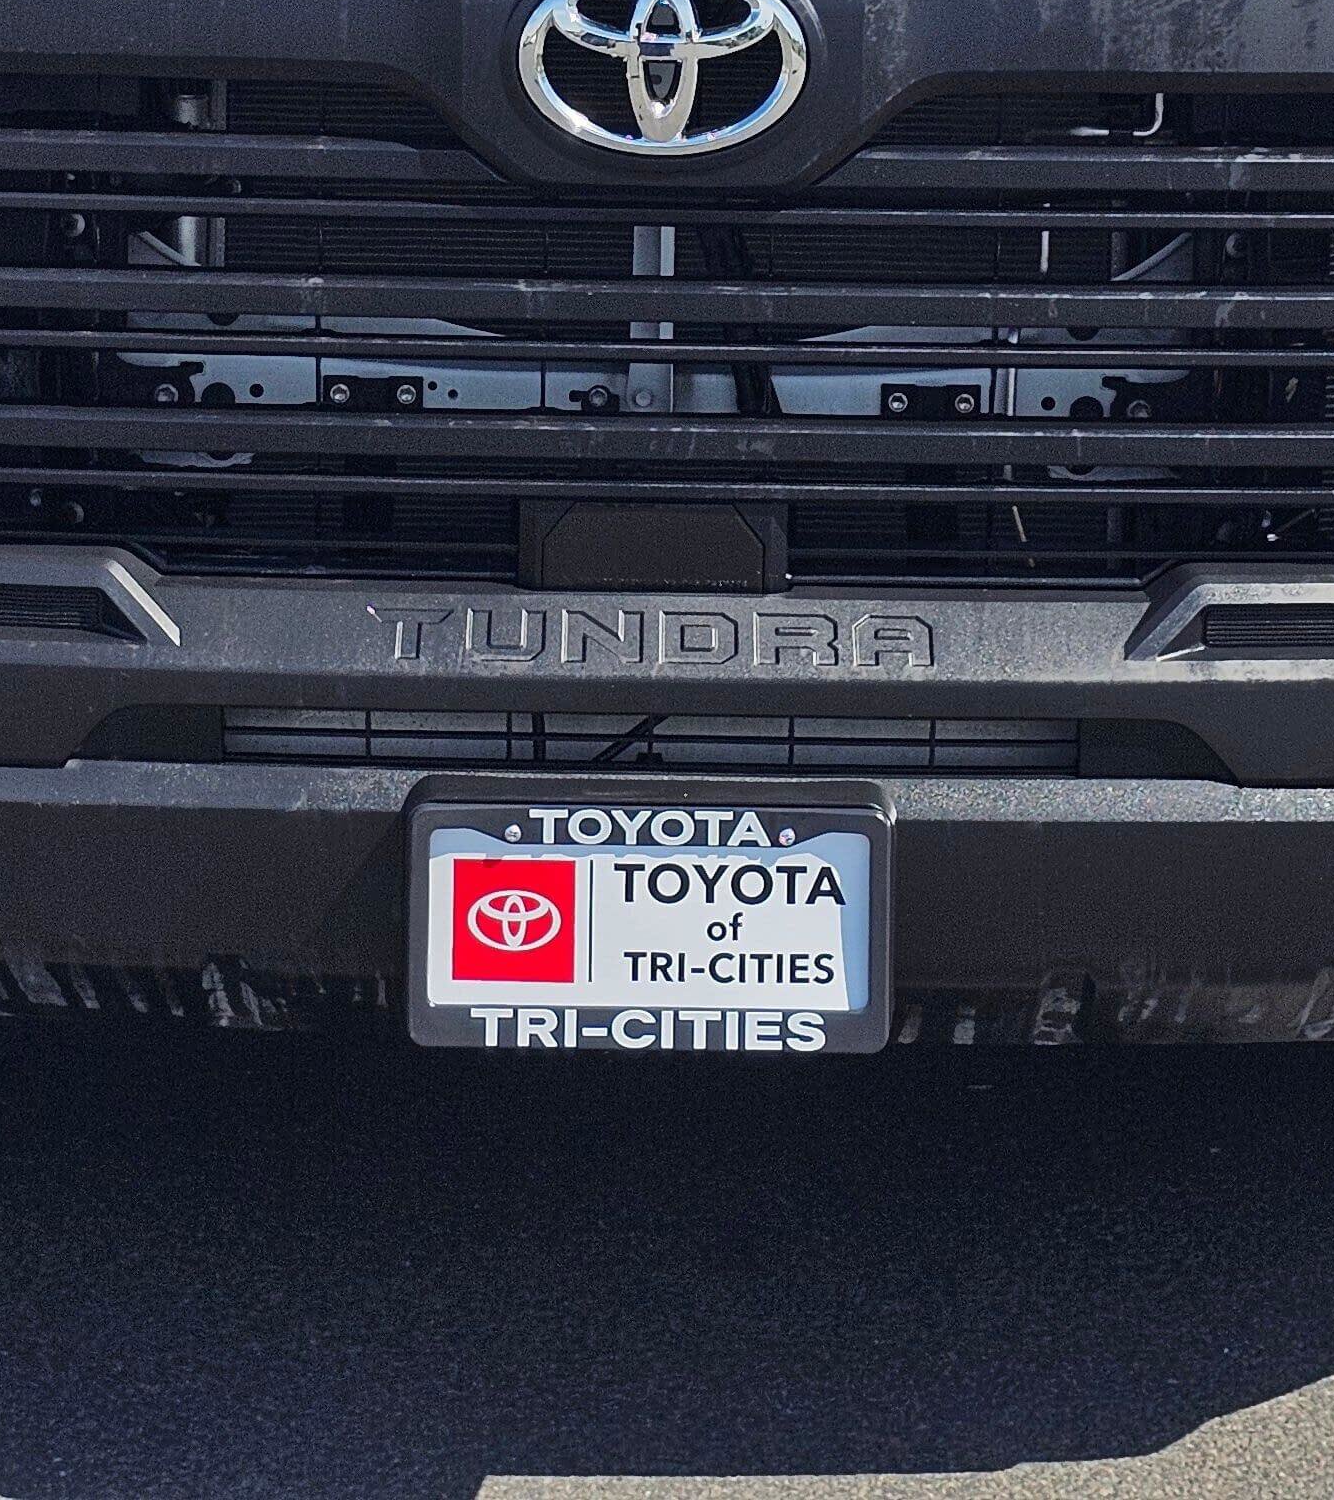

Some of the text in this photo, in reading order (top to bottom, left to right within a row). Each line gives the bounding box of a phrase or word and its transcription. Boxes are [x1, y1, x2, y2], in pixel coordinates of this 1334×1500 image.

[368, 607, 934, 668] TUNDRA
[528, 808, 772, 848] TOYOTA
[614, 863, 846, 906] TOYOTA
[706, 912, 743, 942] of
[623, 951, 835, 985] TRI-CITIES
[470, 1007, 827, 1052] TRI-CITIES
